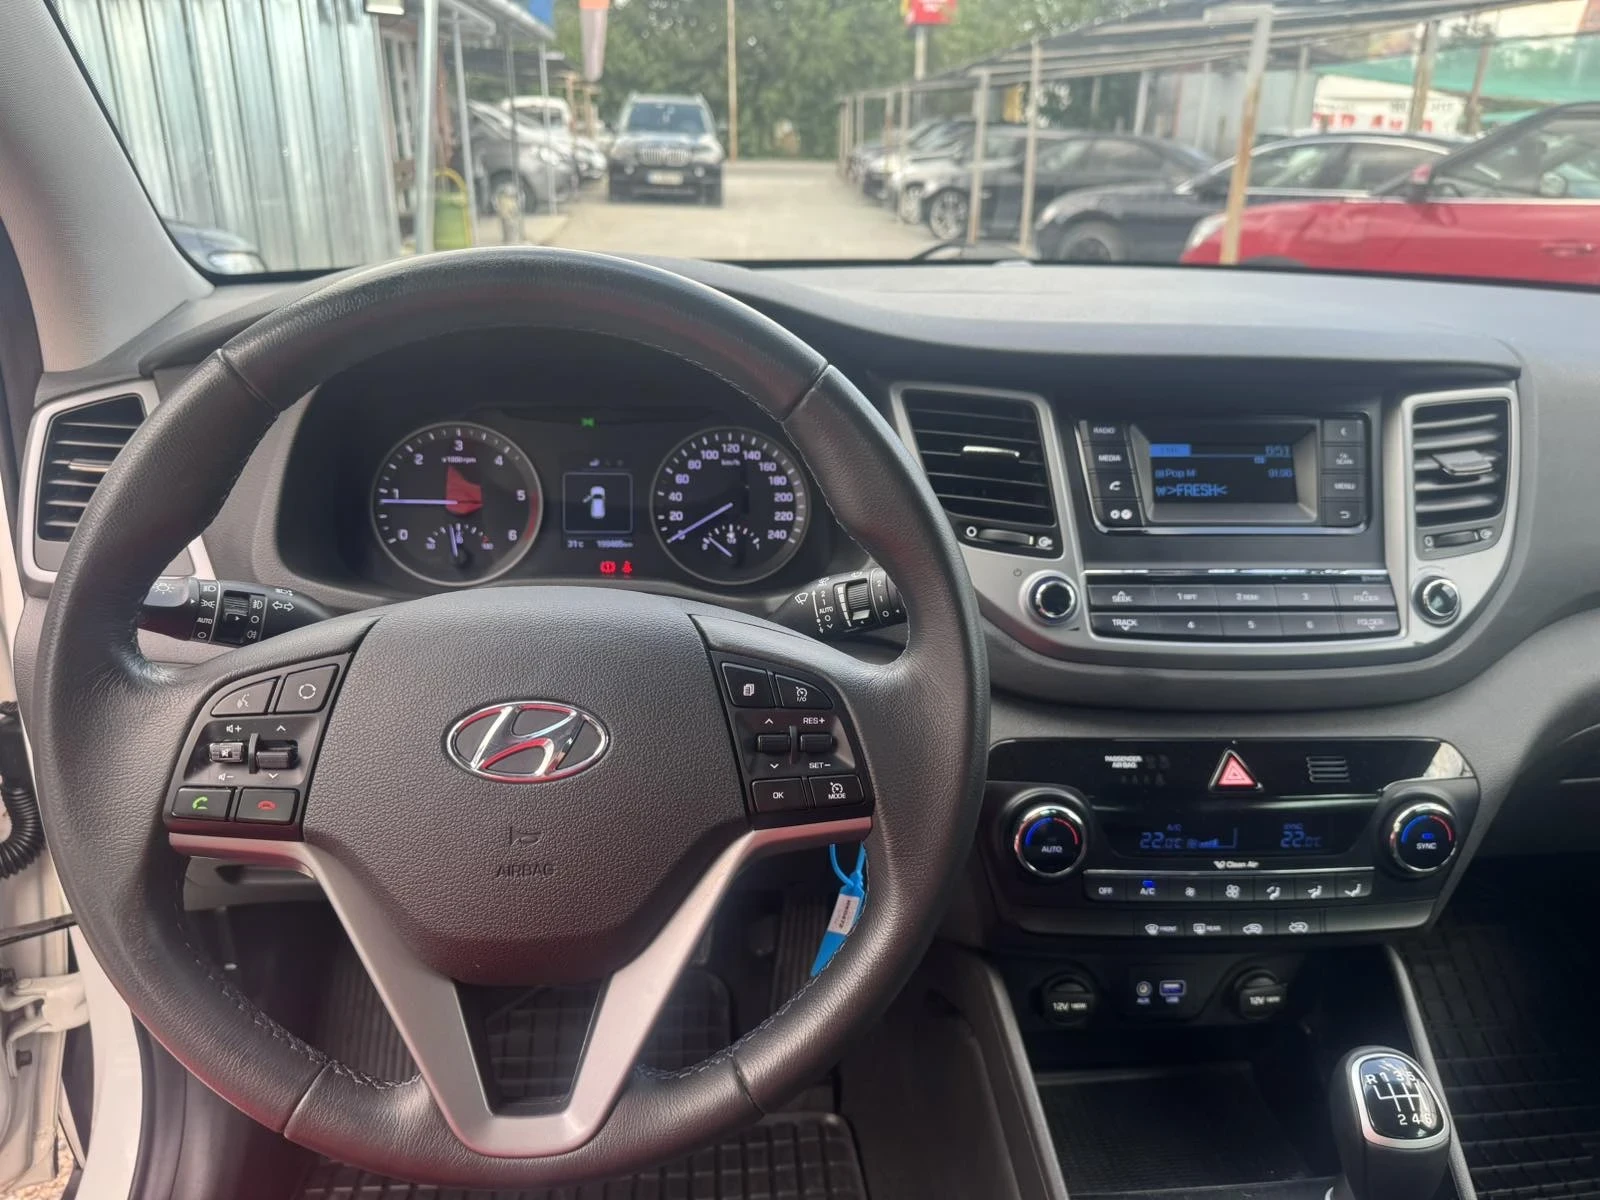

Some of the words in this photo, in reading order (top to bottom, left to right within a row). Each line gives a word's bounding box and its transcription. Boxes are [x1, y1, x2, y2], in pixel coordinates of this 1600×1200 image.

[455, 440, 463, 451] 3
[721, 444, 740, 453] 120
[414, 454, 423, 465] 2
[701, 450, 719, 460] 100
[743, 451, 761, 460] 140
[1098, 454, 1122, 462] MEDIA
[494, 455, 503, 466] 4
[687, 460, 701, 469] 80
[759, 462, 777, 471] 160
[675, 474, 689, 484] 60
[768, 476, 787, 485] 180
[393, 488, 400, 499] 1
[516, 490, 526, 501] 5
[668, 492, 682, 501] 40
[774, 493, 793, 502] 200
[669, 511, 683, 521] 20
[774, 511, 793, 521] 220
[398, 529, 408, 540] 0
[508, 529, 517, 541] 6
[768, 530, 787, 539] 240
[819, 606, 833, 614] AUTO
[1187, 621, 1195, 629] 4
[1247, 621, 1255, 629] 5
[1306, 621, 1314, 629] 6
[803, 717, 825, 725] RES+
[772, 791, 784, 799] OK
[1041, 845, 1063, 853] AUTO
[1416, 842, 1437, 850] SYNC
[496, 863, 555, 879] AIRBAG
[1099, 887, 1113, 895] OFF
[1053, 1002, 1069, 1011] 12V
[1365, 1074, 1378, 1085] R
[1398, 1114, 1408, 1125] 2
[1412, 1113, 1421, 1125] 4
